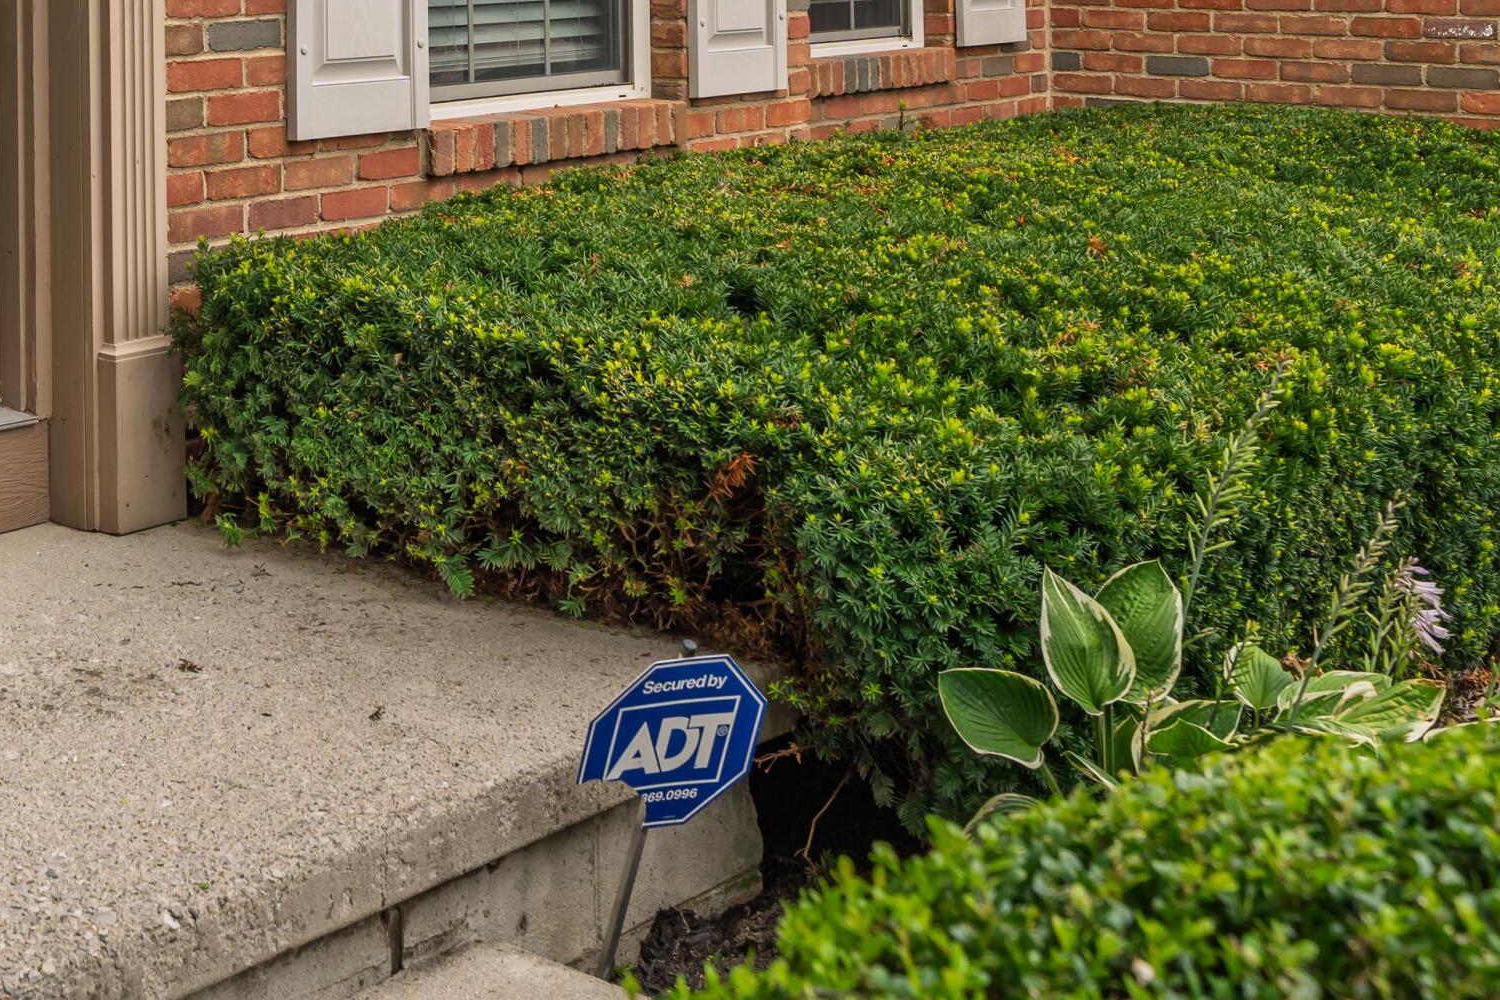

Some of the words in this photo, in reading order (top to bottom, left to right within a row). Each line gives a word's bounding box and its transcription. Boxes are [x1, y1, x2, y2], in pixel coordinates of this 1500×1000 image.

[642, 674, 706, 695] Secured
[707, 673, 728, 690] by
[606, 711, 735, 780] ADT
